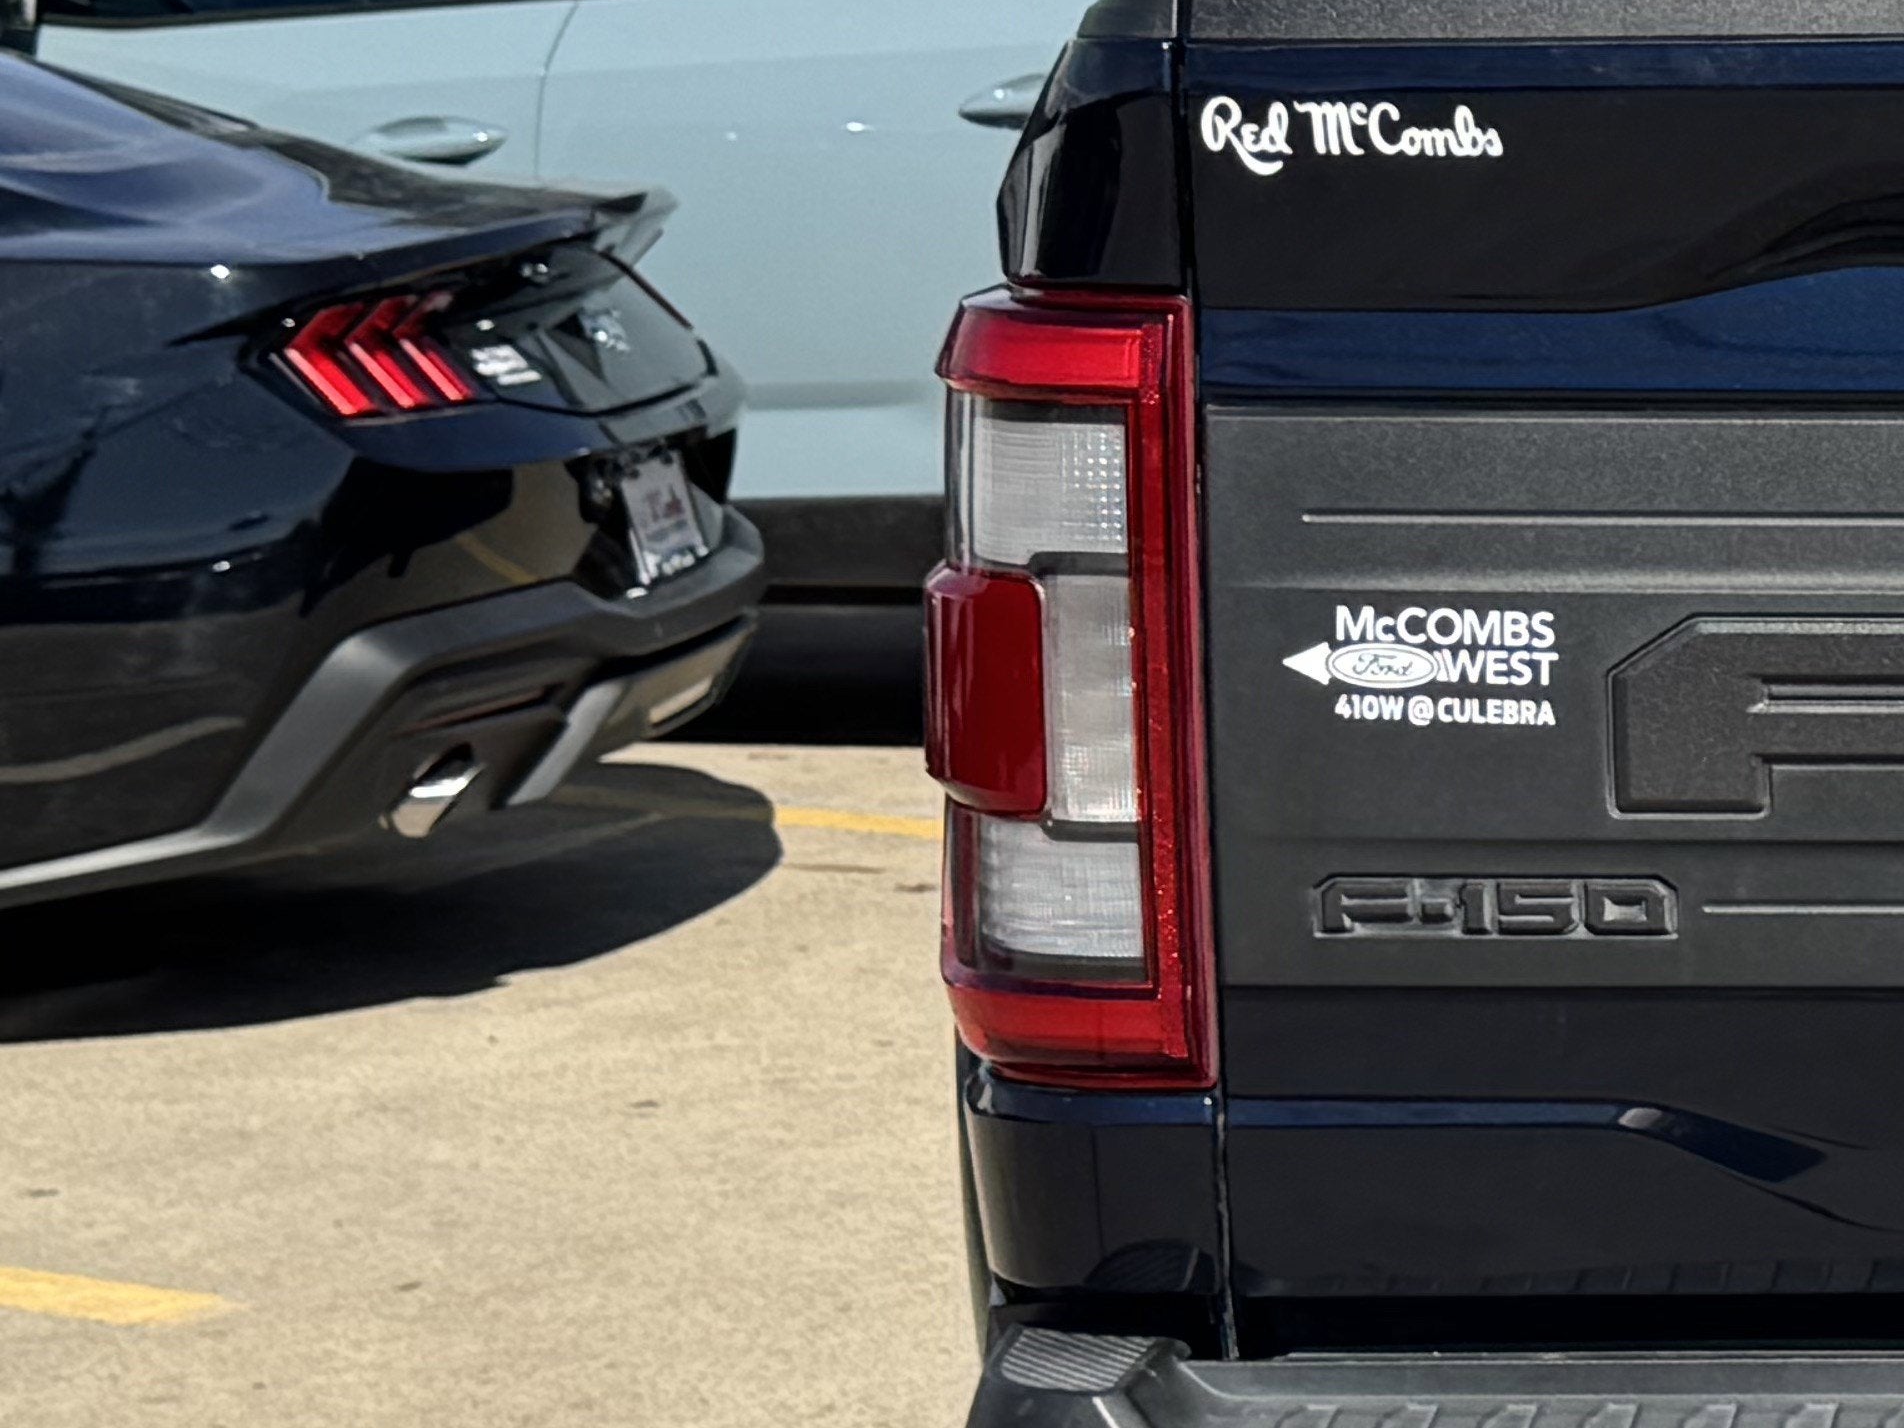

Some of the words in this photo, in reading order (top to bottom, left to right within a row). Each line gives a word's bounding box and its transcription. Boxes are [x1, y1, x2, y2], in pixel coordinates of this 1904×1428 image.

[1201, 95, 1292, 176] Red
[1294, 101, 1503, 157] McCombs
[1335, 605, 1555, 648] McCOMBS
[1352, 652, 1414, 677] Ford
[1441, 649, 1560, 686] WEST
[1313, 874, 1680, 938] F-150
